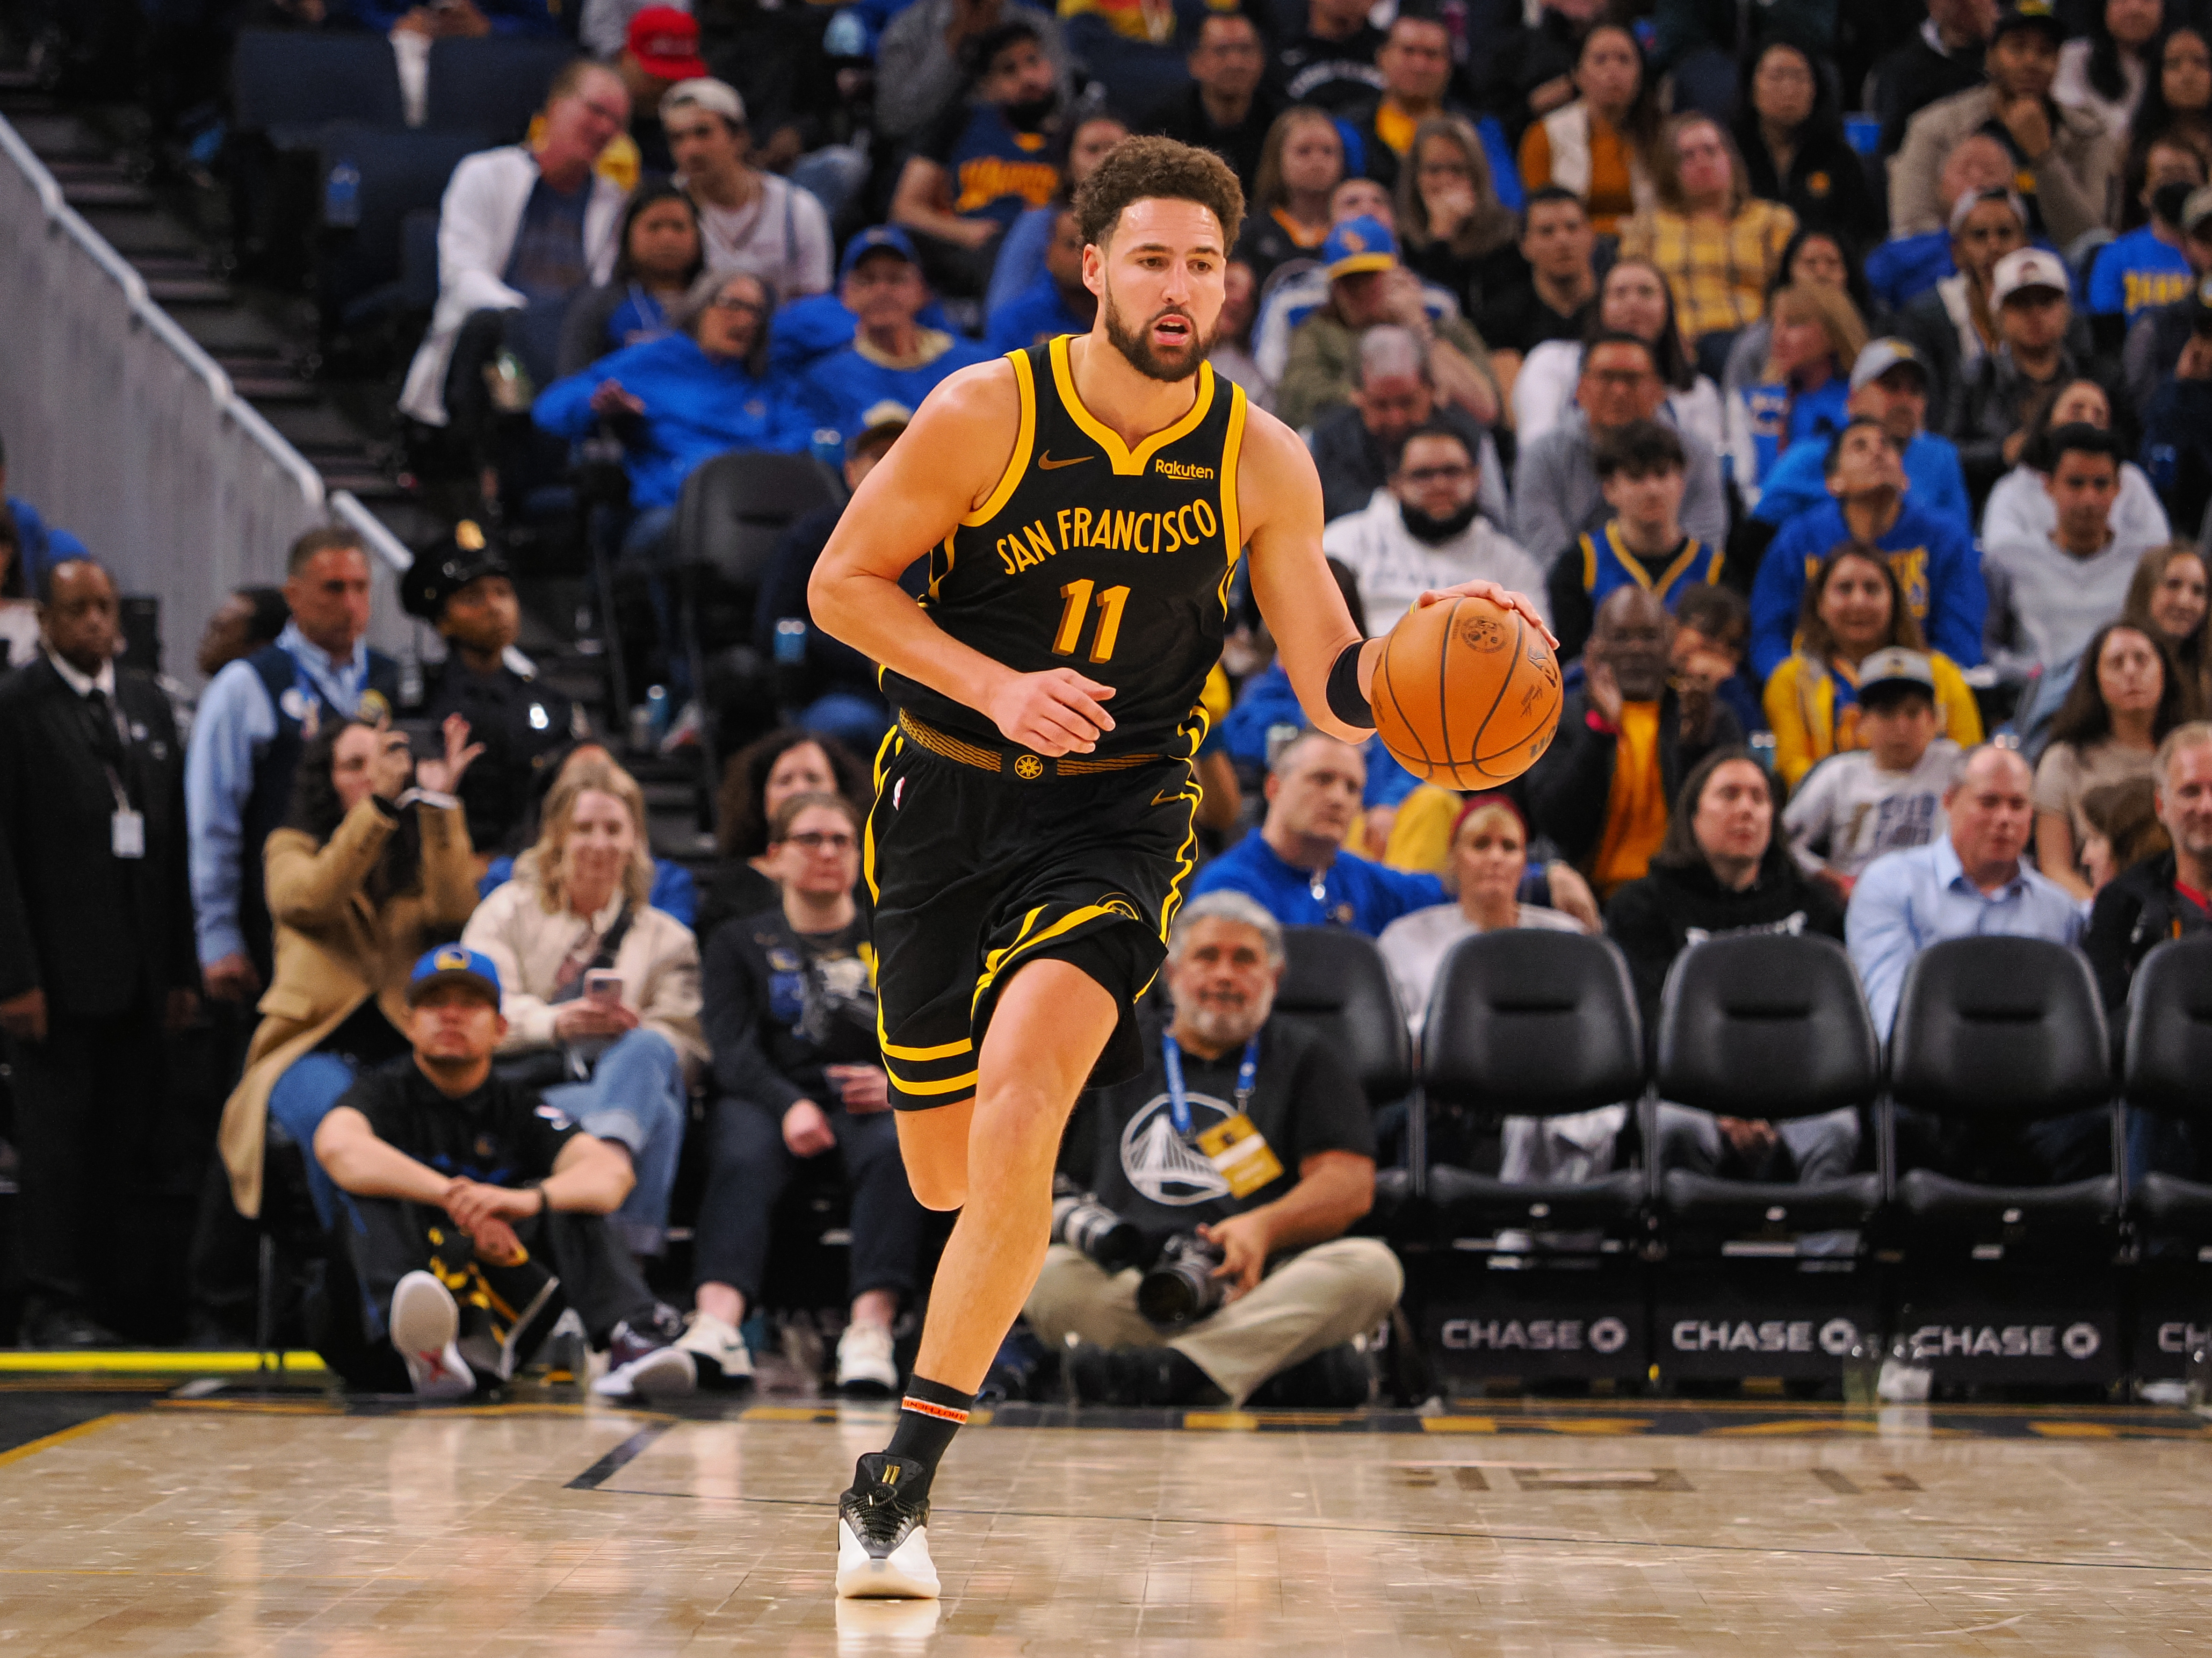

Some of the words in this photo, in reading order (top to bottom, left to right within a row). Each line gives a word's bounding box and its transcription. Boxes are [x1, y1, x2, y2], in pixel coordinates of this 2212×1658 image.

[1155, 459, 1214, 480] Rakuten
[997, 520, 1056, 575] SAN
[1057, 499, 1216, 553] FRANCISCO
[1052, 578, 1130, 663] 11
[1442, 1319, 1584, 1350] CHASE
[1672, 1320, 1814, 1352] CHASE
[1910, 1325, 2056, 1356] CHASE
